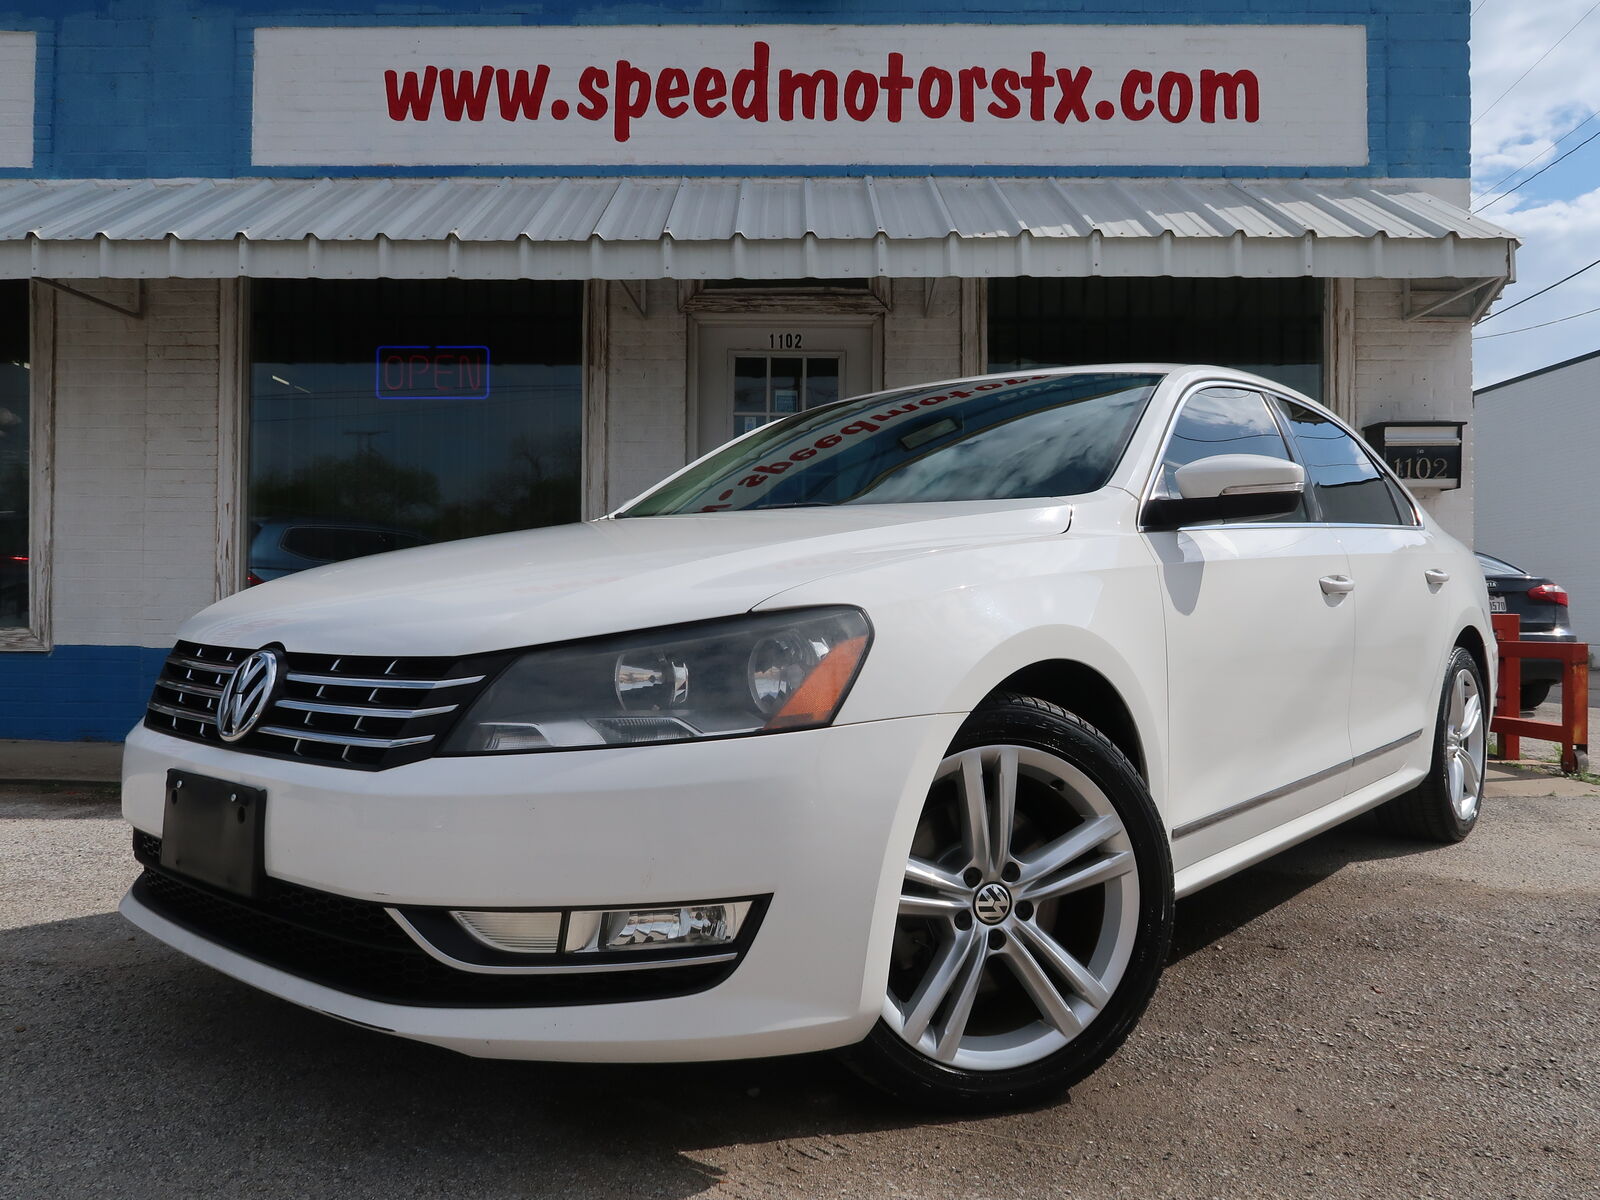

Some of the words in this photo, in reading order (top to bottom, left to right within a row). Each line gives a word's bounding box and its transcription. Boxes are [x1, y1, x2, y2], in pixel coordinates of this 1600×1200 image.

[384, 41, 1259, 142] www.speedmotorstx.com
[770, 333, 802, 349] 1102
[384, 355, 481, 390] OPEN
[1394, 457, 1448, 479] 1102
